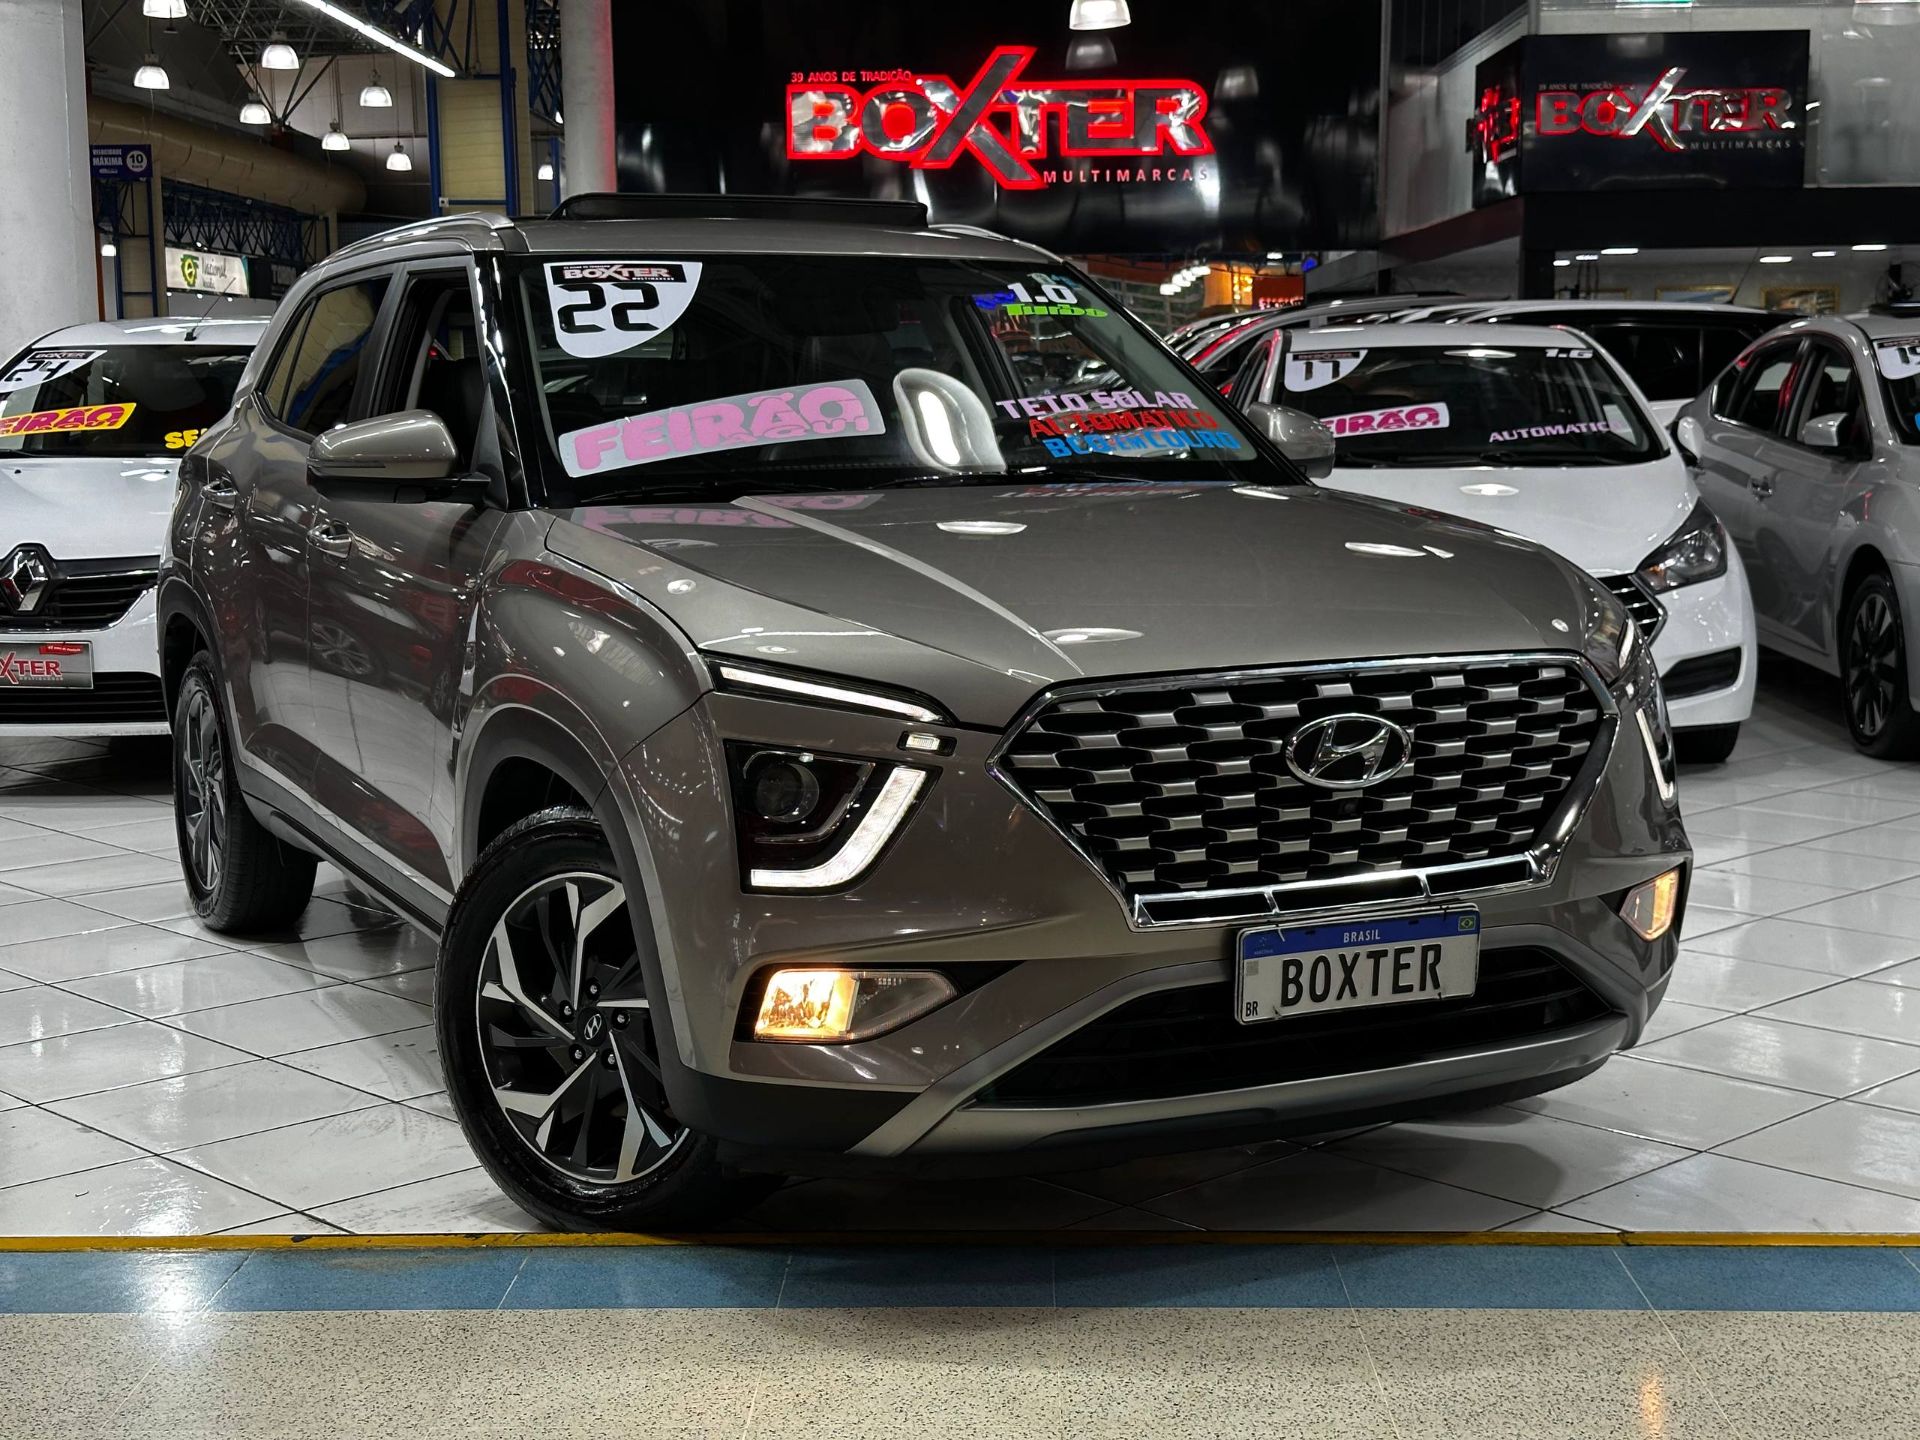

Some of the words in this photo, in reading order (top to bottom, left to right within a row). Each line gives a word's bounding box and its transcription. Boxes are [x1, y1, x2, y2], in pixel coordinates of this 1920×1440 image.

[808, 71, 838, 82] ANOS
[841, 71, 857, 82] DE
[787, 46, 1215, 190] BOXTER
[1536, 66, 1797, 152] BOXTER
[1690, 140, 1791, 150] MULTIMARCAS
[92, 156, 123, 166] MÁXIMA
[129, 153, 144, 164] 10
[1043, 168, 1208, 183] MULTIMARCAS
[563, 264, 671, 280] BOXTER
[1007, 282, 1078, 304] 1.0
[557, 282, 661, 334] 22
[1002, 303, 1108, 318] Turbo
[1545, 349, 1593, 358] 1.6
[4, 360, 70, 381] 24
[996, 393, 1085, 419] TETO
[1092, 390, 1199, 411] SOLAR
[574, 386, 866, 470] FEIRÃO
[164, 427, 208, 449] SE
[1144, 429, 1242, 450] COURO
[1343, 928, 1381, 943] BRASIL
[1280, 943, 1442, 1007] BOXTER
[1245, 1001, 1258, 1017] BR
